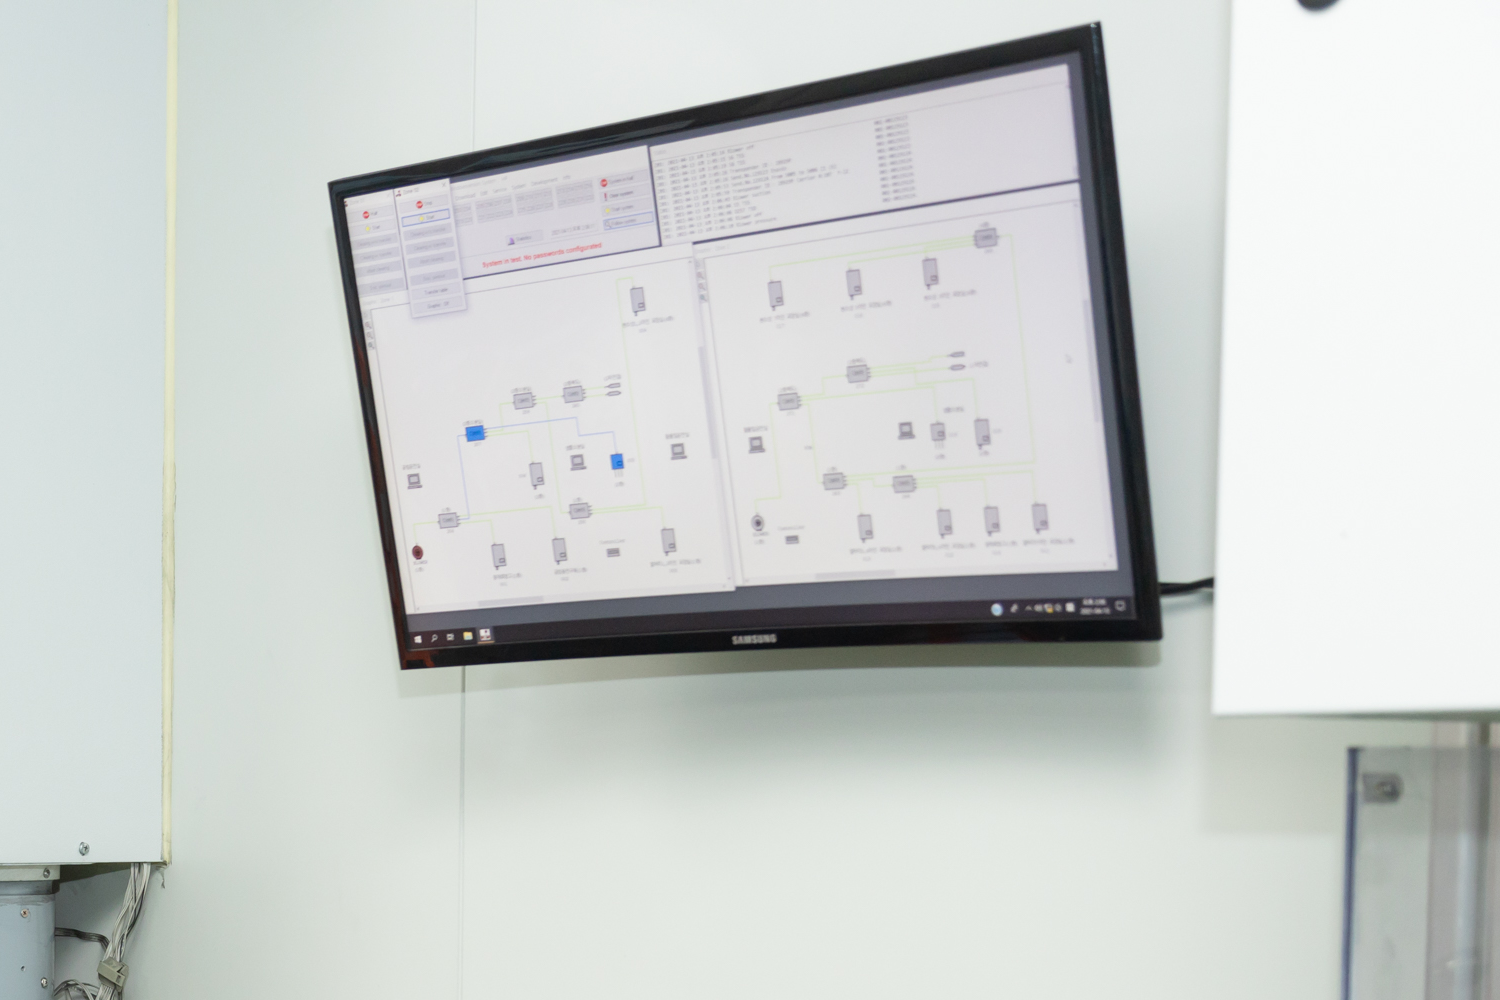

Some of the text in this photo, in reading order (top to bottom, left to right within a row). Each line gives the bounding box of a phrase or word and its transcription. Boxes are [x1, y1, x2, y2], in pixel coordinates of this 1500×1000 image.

[482, 256, 502, 268] System
[524, 252, 532, 262] No
[533, 248, 565, 260] passwords
[732, 634, 777, 646] SAMSUNG
